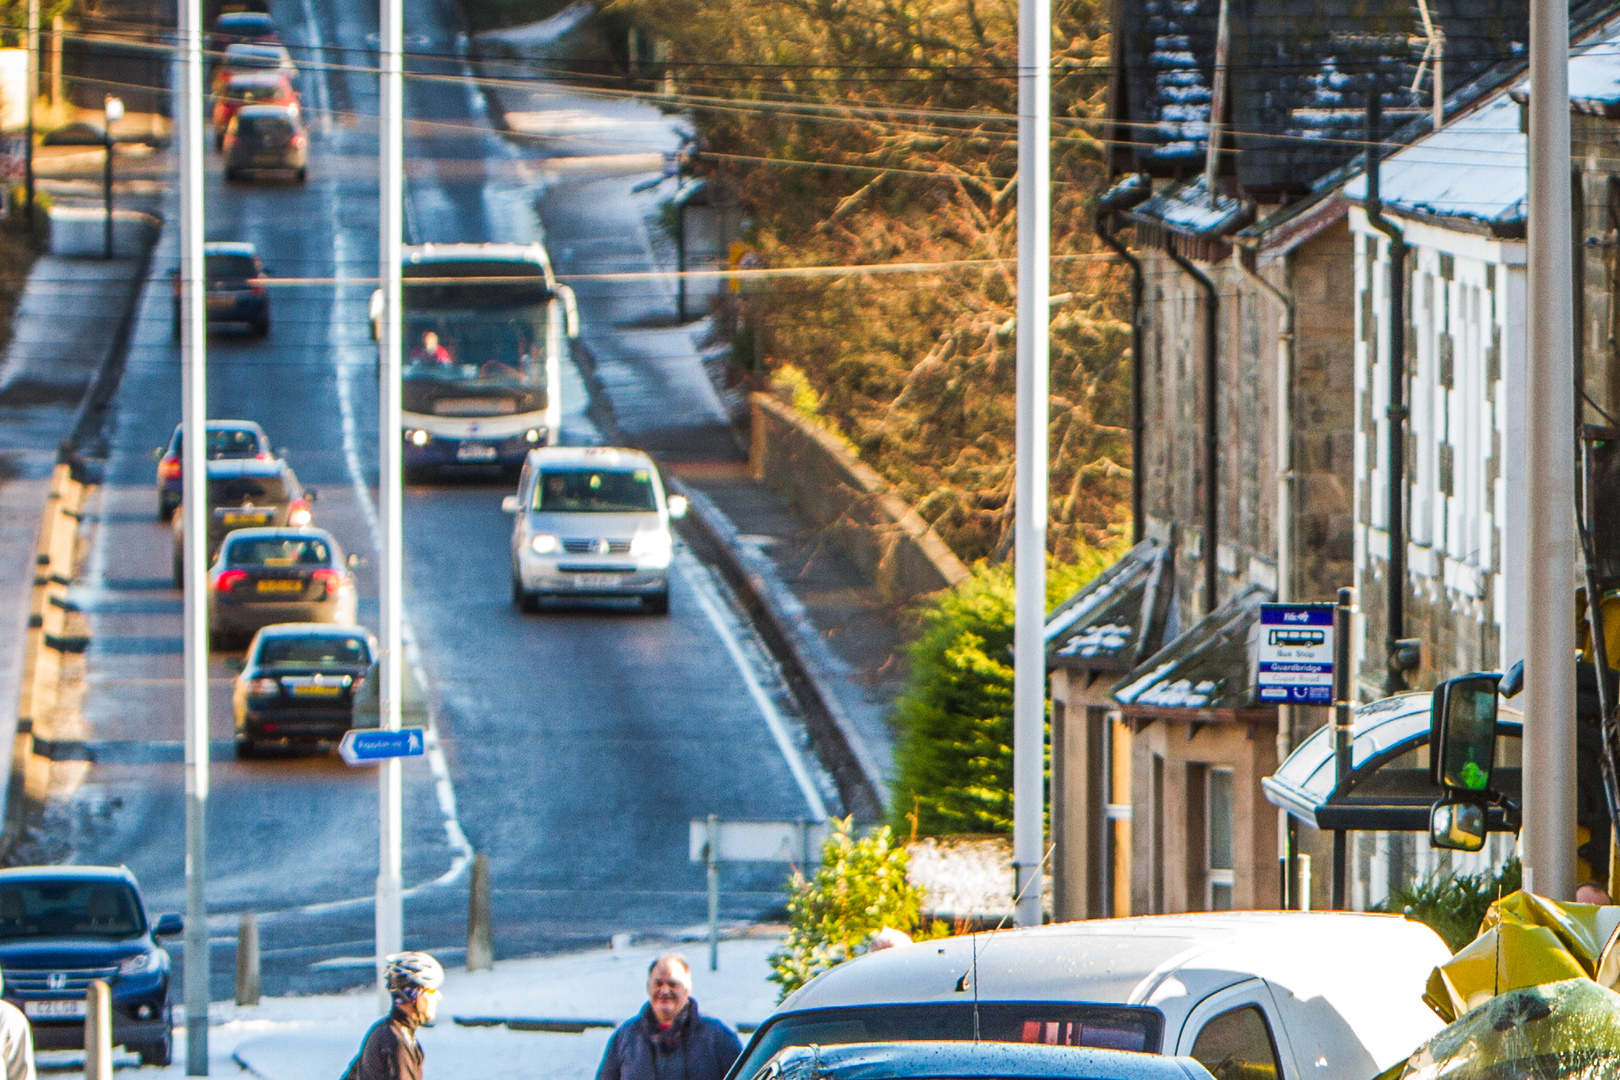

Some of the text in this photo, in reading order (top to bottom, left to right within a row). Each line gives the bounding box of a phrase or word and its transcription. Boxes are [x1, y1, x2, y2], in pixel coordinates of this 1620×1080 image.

[1277, 649, 1315, 658] Bus Stop
[1271, 662, 1322, 673] Guardbridge
[1299, 674, 1320, 682] Road
